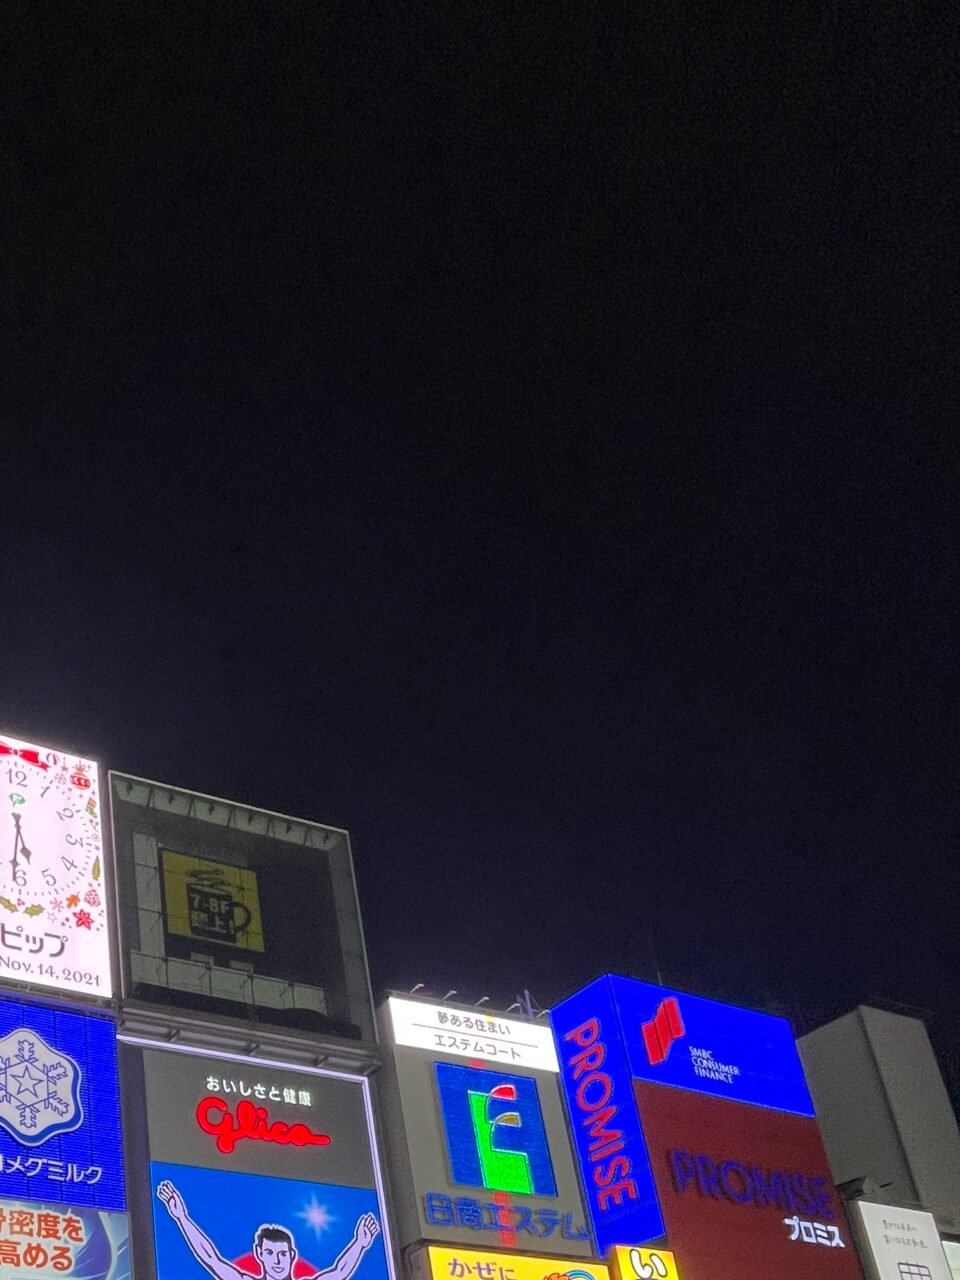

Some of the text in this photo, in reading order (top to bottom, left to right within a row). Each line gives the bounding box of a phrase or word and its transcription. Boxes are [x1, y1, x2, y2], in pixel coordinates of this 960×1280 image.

[5, 768, 28, 788] 12
[0, 922, 68, 957] ピップ
[436, 1011, 511, 1036] 夢ある住まい
[434, 1034, 522, 1060] エステムコート
[689, 1046, 713, 1061] SMBC
[691, 1056, 740, 1076] CONSUMER
[694, 1066, 734, 1084] FINANCE
[206, 1076, 312, 1107] おいしさと健康
[196, 1096, 331, 1153] Glico
[564, 1017, 638, 1212] PROMISE
[671, 1149, 835, 1218] PROMISE
[425, 1192, 591, 1241] 日商エステム
[783, 1216, 846, 1248] プロミス
